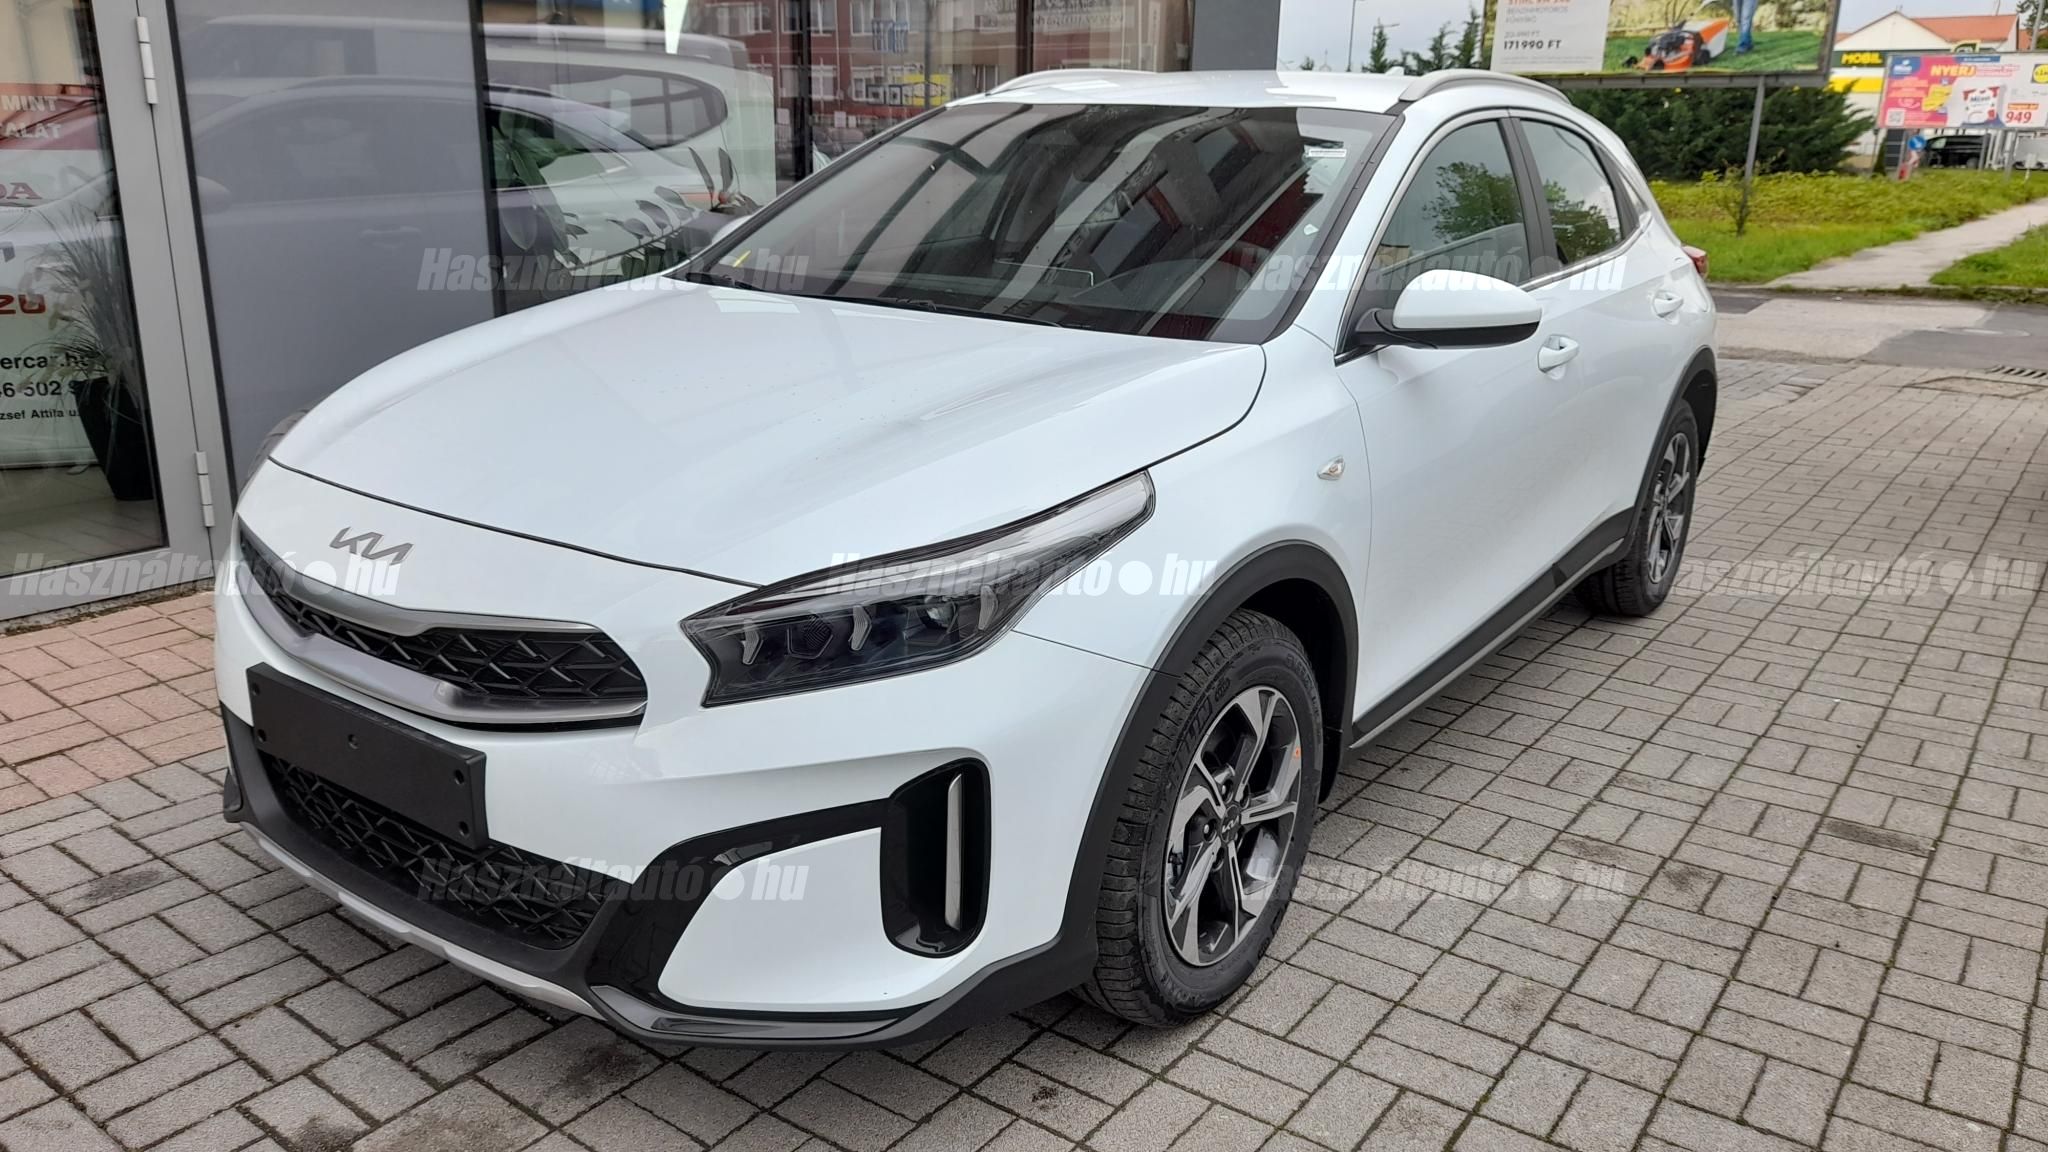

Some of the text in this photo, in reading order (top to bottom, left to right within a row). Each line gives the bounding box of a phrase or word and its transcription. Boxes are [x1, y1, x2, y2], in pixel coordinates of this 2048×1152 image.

[1548, 40, 1561, 48] FT
[1841, 52, 1882, 65] MOBIL
[2006, 111, 2032, 123] 949
[31, 409, 65, 419] Attila
